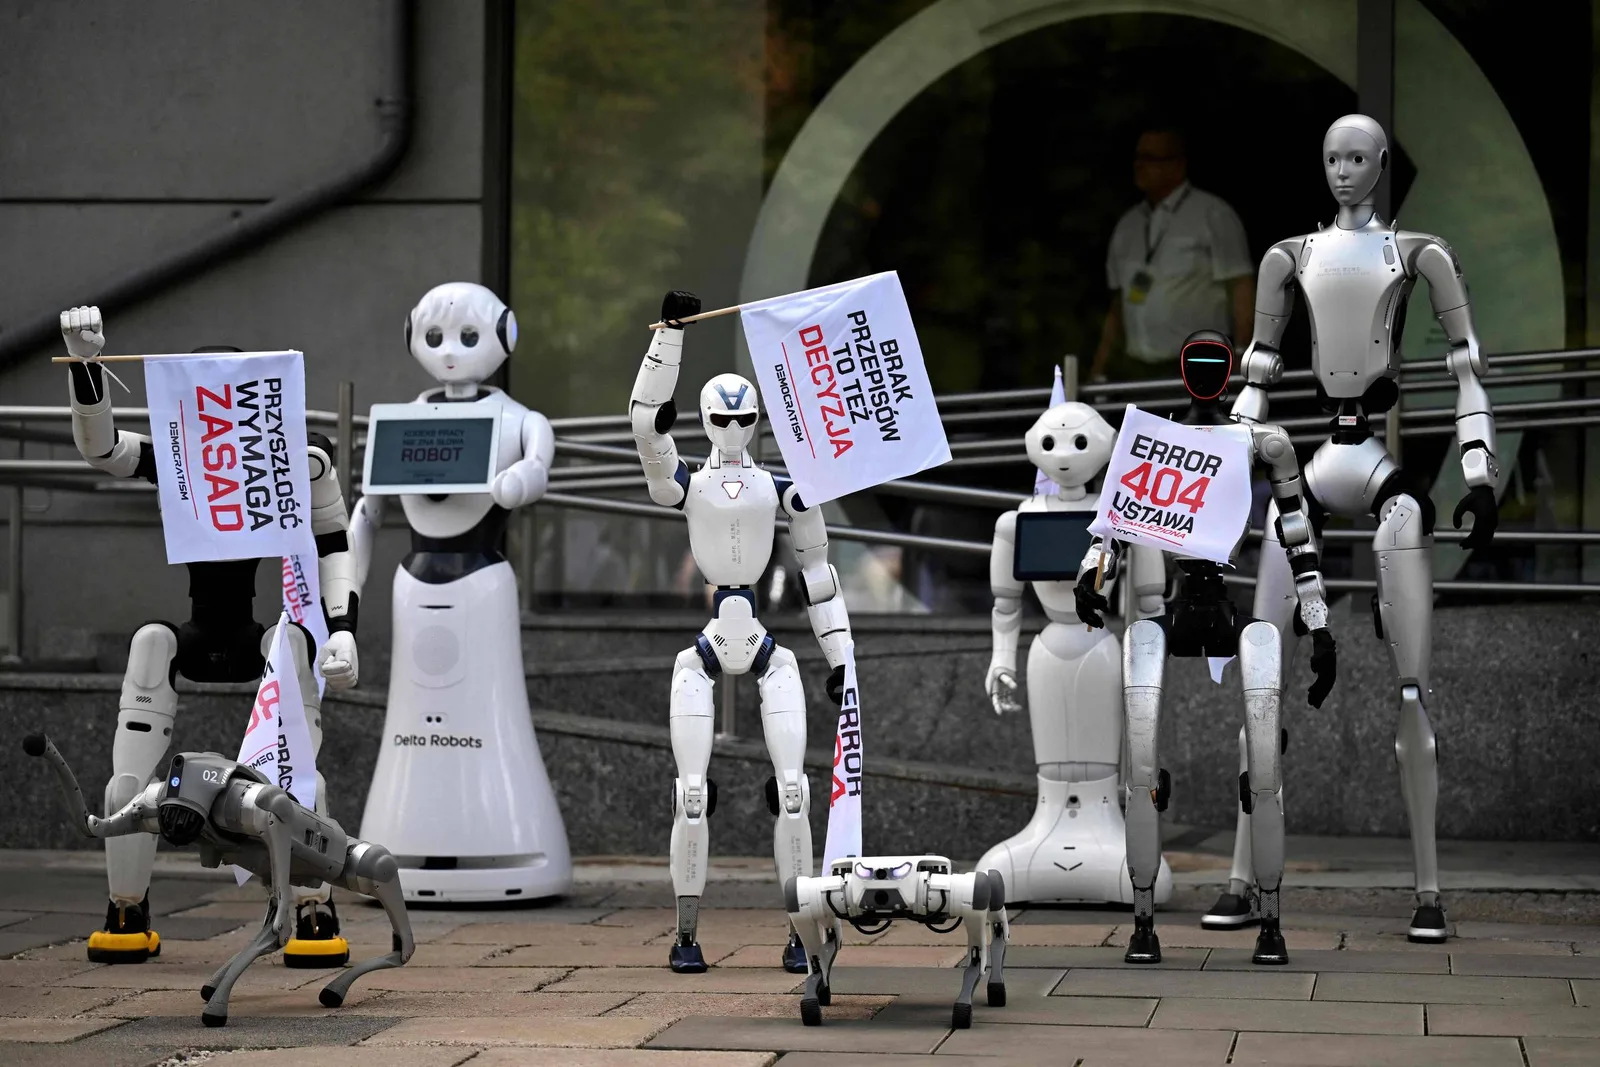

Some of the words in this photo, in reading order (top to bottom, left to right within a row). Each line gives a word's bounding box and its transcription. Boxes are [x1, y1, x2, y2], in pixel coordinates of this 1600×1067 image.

[832, 342, 856, 376] TO
[847, 310, 902, 442] PRZEPISÓW
[879, 338, 914, 404] BRAK
[774, 363, 805, 443] DEMOCRATISM
[798, 324, 854, 459] DECYZJA
[842, 378, 873, 425] TEŻ
[169, 421, 189, 501] DEMOCRATISM
[196, 384, 245, 532] ZASAD
[235, 380, 274, 532] WYMAGA
[264, 378, 303, 530] PRZYSZŁOŚĆ
[401, 447, 464, 462] ROBOT
[1130, 433, 1223, 477] ERROR
[1112, 491, 1195, 534] USTAWA
[1120, 461, 1211, 514] 404
[394, 734, 427, 747] Delta
[430, 734, 482, 749] Robots
[202, 769, 218, 782] 02
